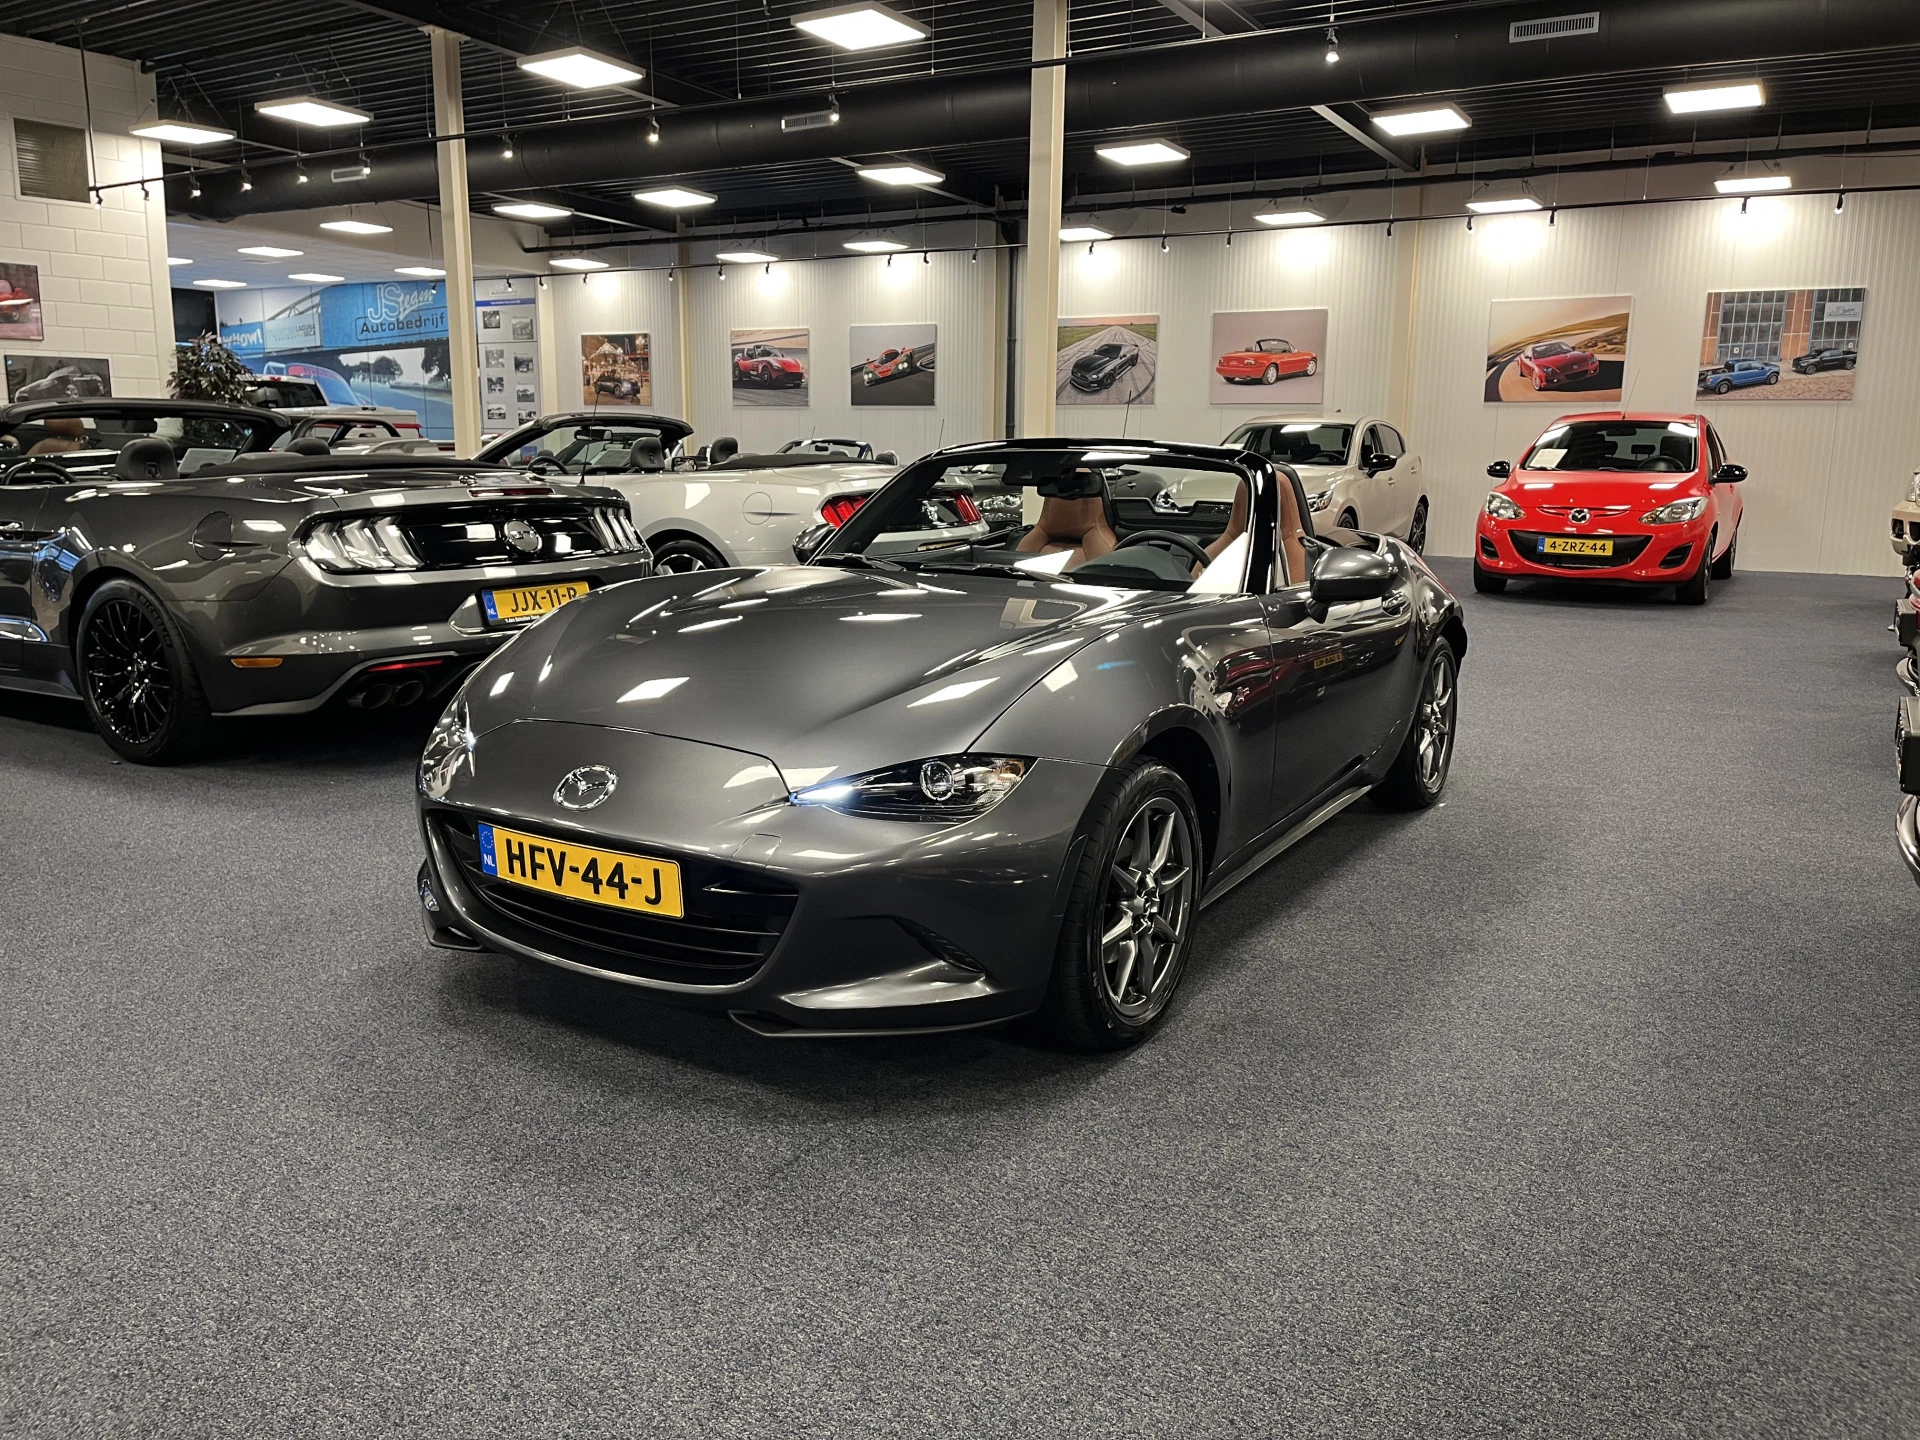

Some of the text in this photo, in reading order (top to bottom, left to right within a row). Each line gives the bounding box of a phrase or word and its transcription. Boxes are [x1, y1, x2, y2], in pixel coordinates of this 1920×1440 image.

[360, 312, 445, 335] Autobedrijf
[1549, 541, 1606, 553] 4-ZRZ-44
[487, 608, 497, 616] NL
[483, 852, 495, 868] NL
[506, 838, 662, 906] HFV-44-J
